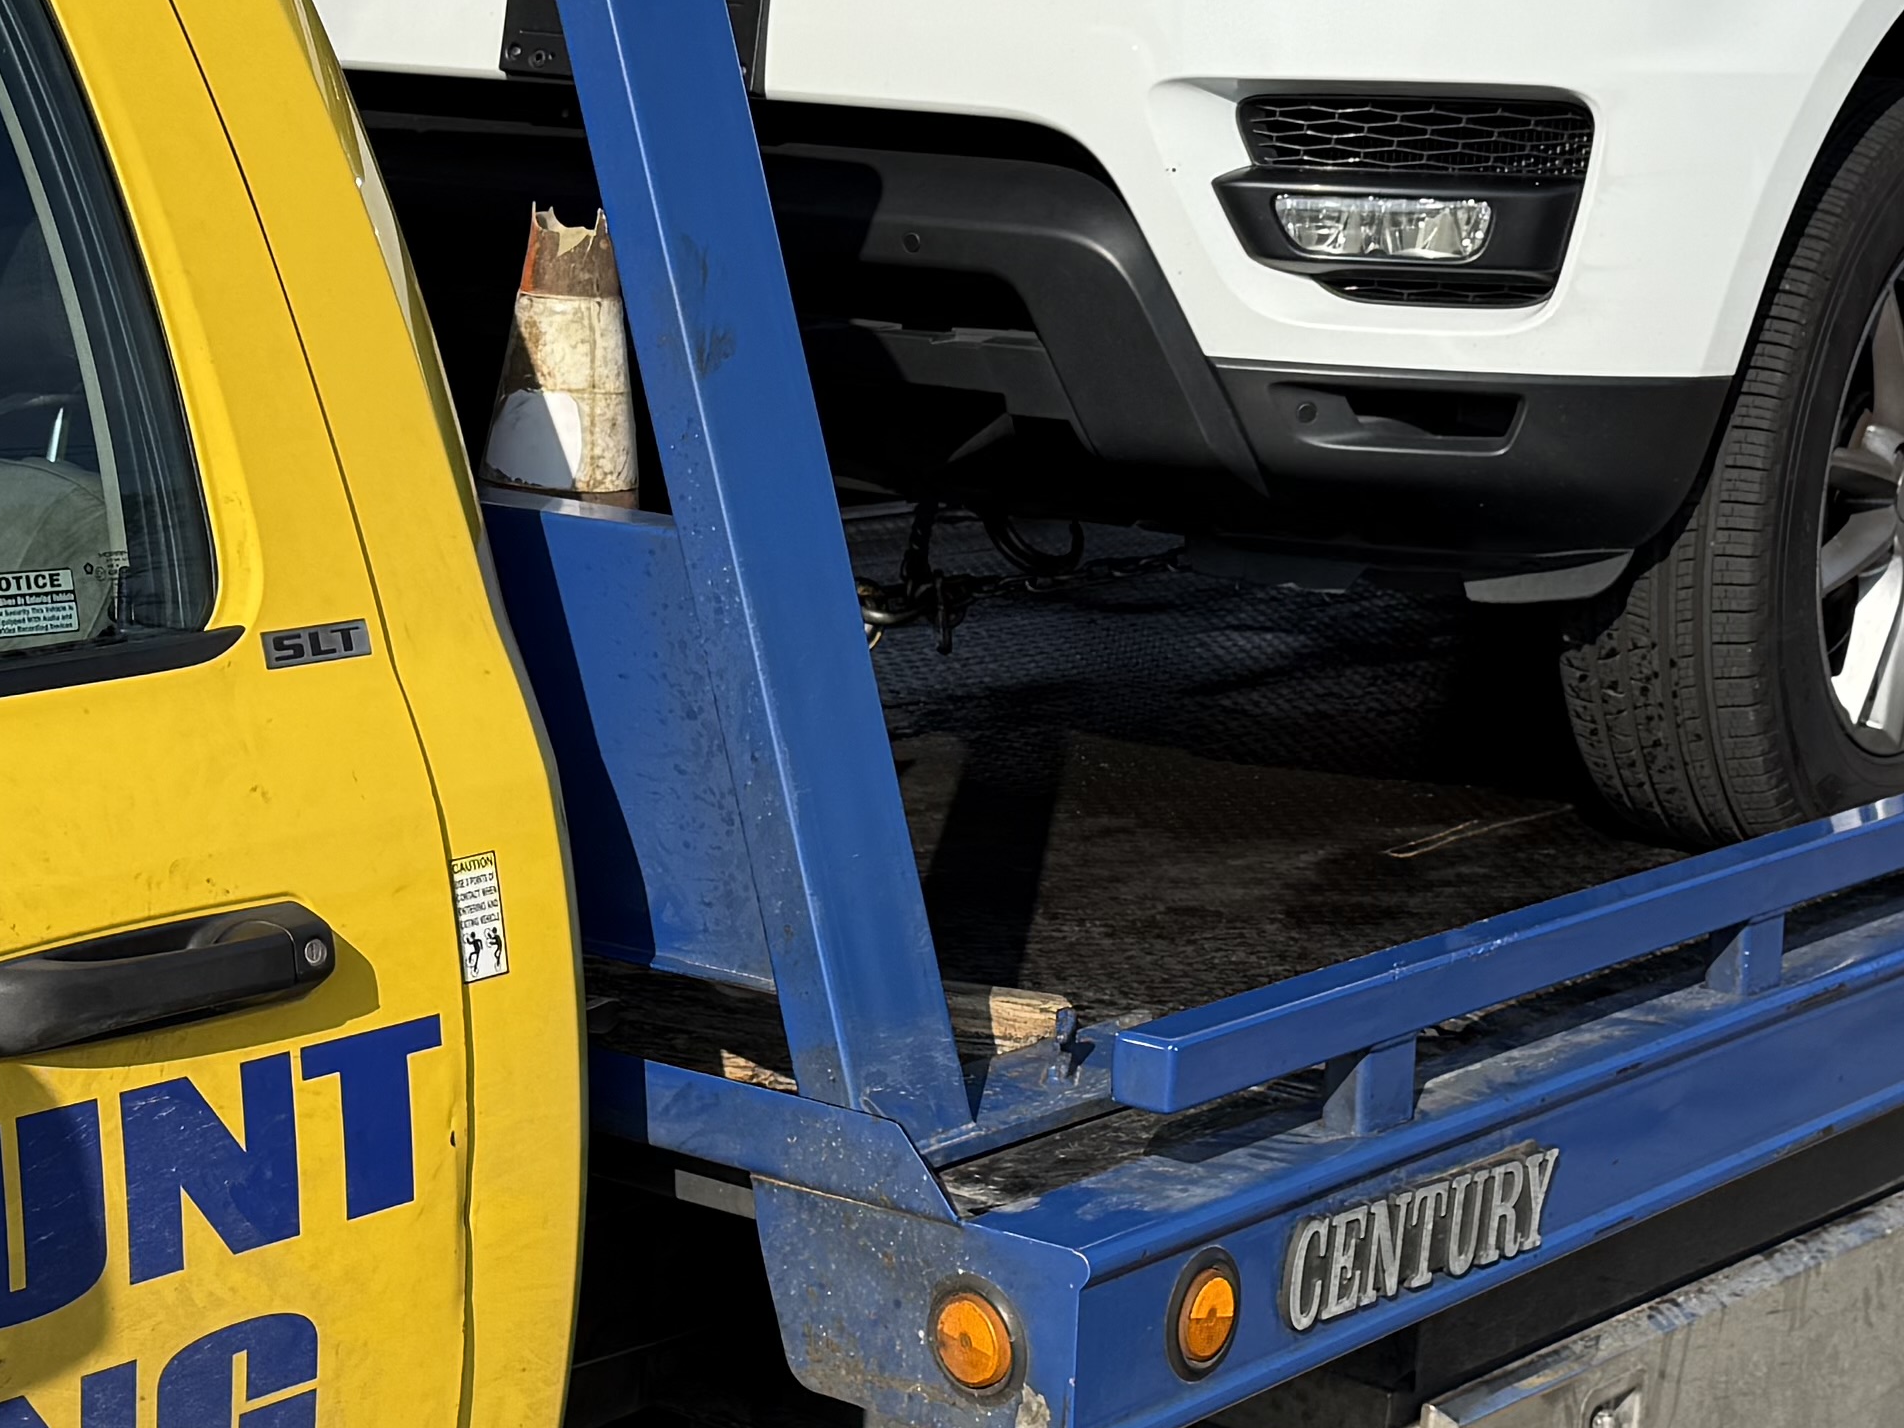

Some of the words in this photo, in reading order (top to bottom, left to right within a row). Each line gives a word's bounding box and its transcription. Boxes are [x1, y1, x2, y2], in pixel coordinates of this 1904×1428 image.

[273, 626, 360, 663] SLT
[452, 856, 493, 874] CAUTION
[1288, 1148, 1560, 1330] CENTURY
